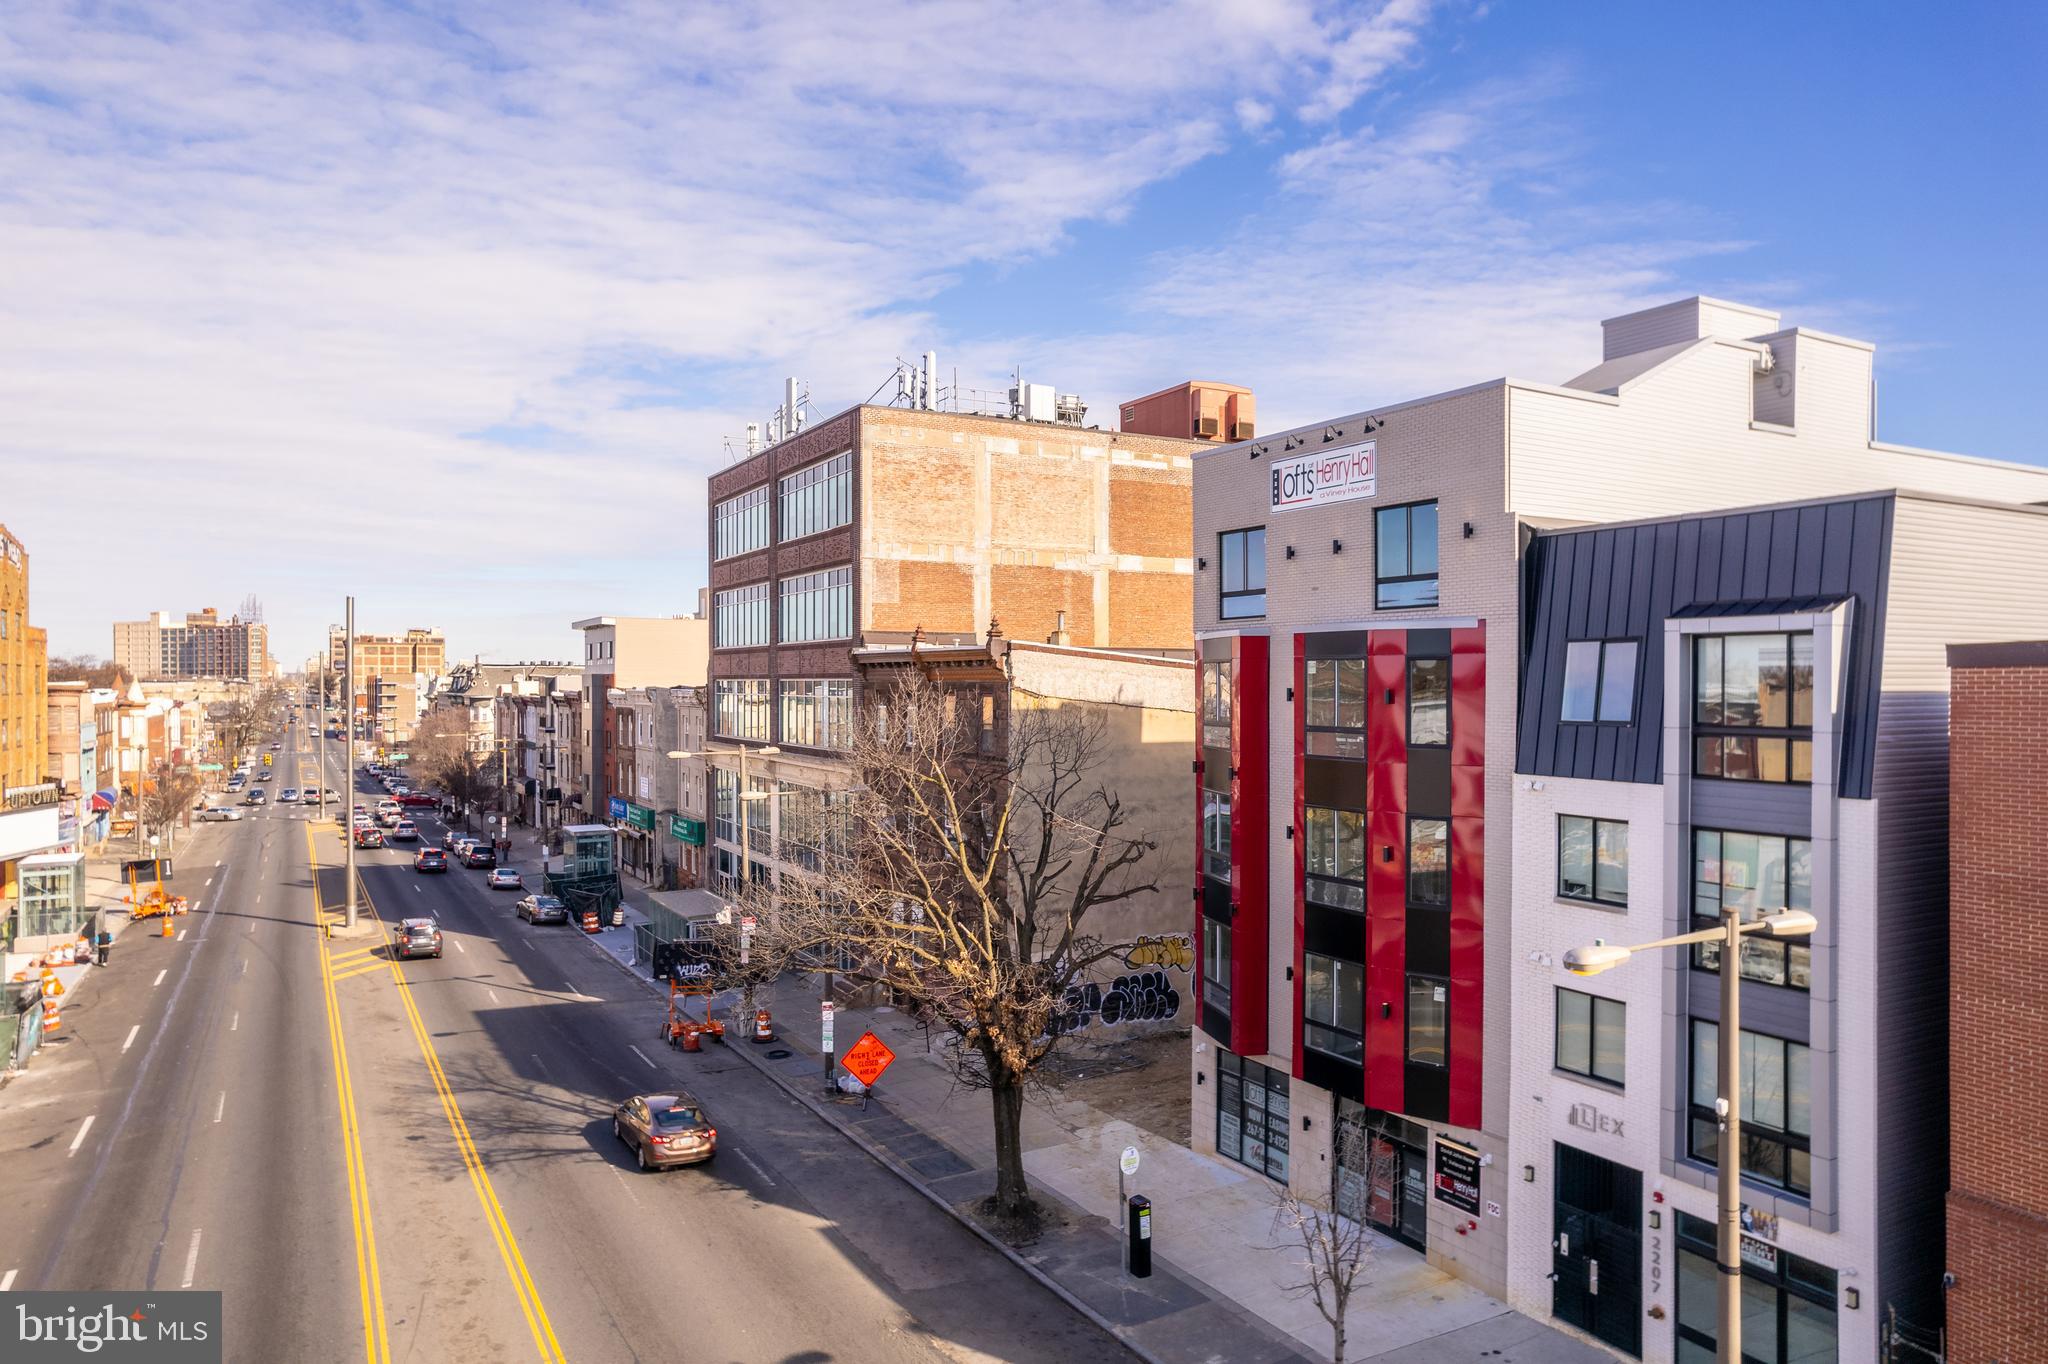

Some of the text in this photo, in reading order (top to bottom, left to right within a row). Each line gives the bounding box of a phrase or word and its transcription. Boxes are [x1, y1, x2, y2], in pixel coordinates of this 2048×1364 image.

[1316, 458, 1350, 485] Henry
[1352, 449, 1374, 477] Hall
[1348, 484, 1371, 494] House
[10, 788, 59, 807] UPTOWN
[850, 1050, 886, 1060] RIGHT LANE
[858, 1059, 879, 1068] CLOSED
[860, 1067, 877, 1075] AHEAD
[1488, 1202, 1500, 1215] FDC
[1651, 1236, 1661, 1293] 2207
